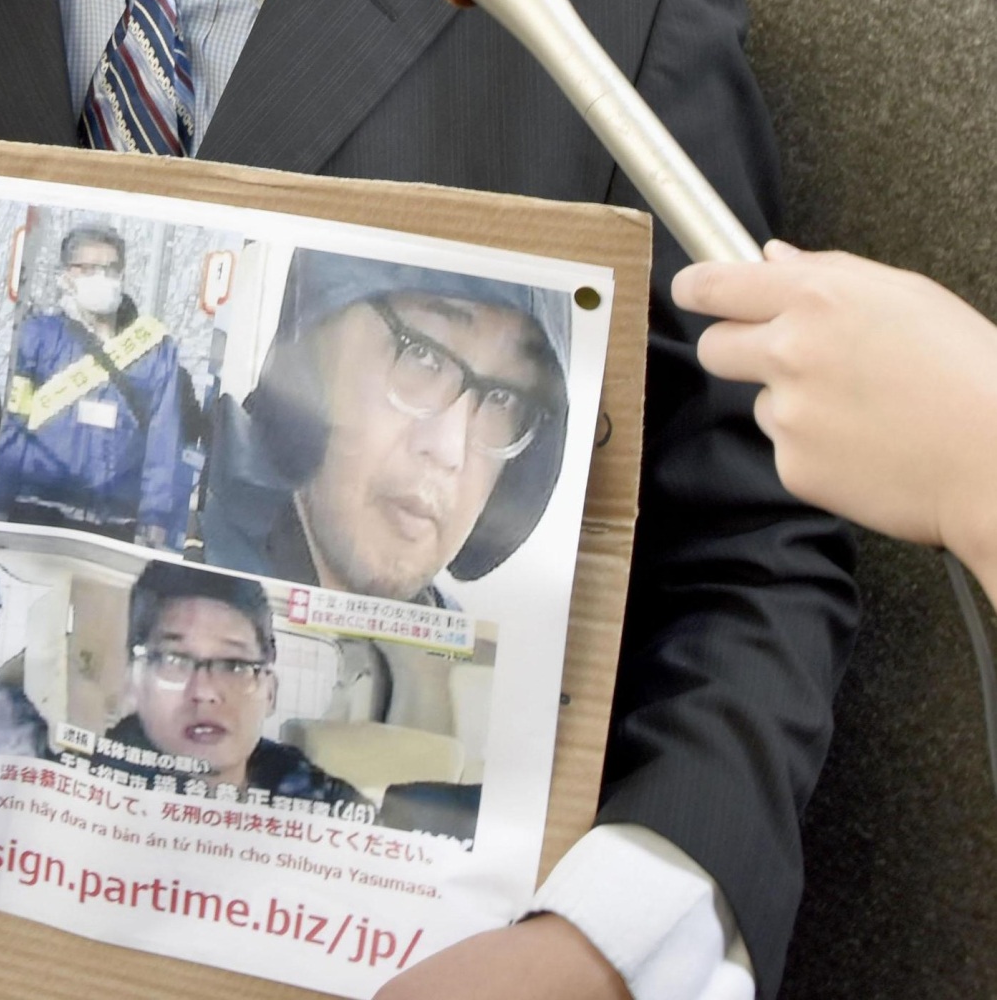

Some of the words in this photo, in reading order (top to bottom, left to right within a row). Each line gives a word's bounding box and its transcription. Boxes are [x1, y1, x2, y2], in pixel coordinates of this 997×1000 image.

[91, 822, 107, 837] ra
[145, 832, 167, 849] án
[239, 846, 271, 865] cho
[275, 853, 342, 880] Shibuya
[348, 866, 443, 899] Yasumasa.
